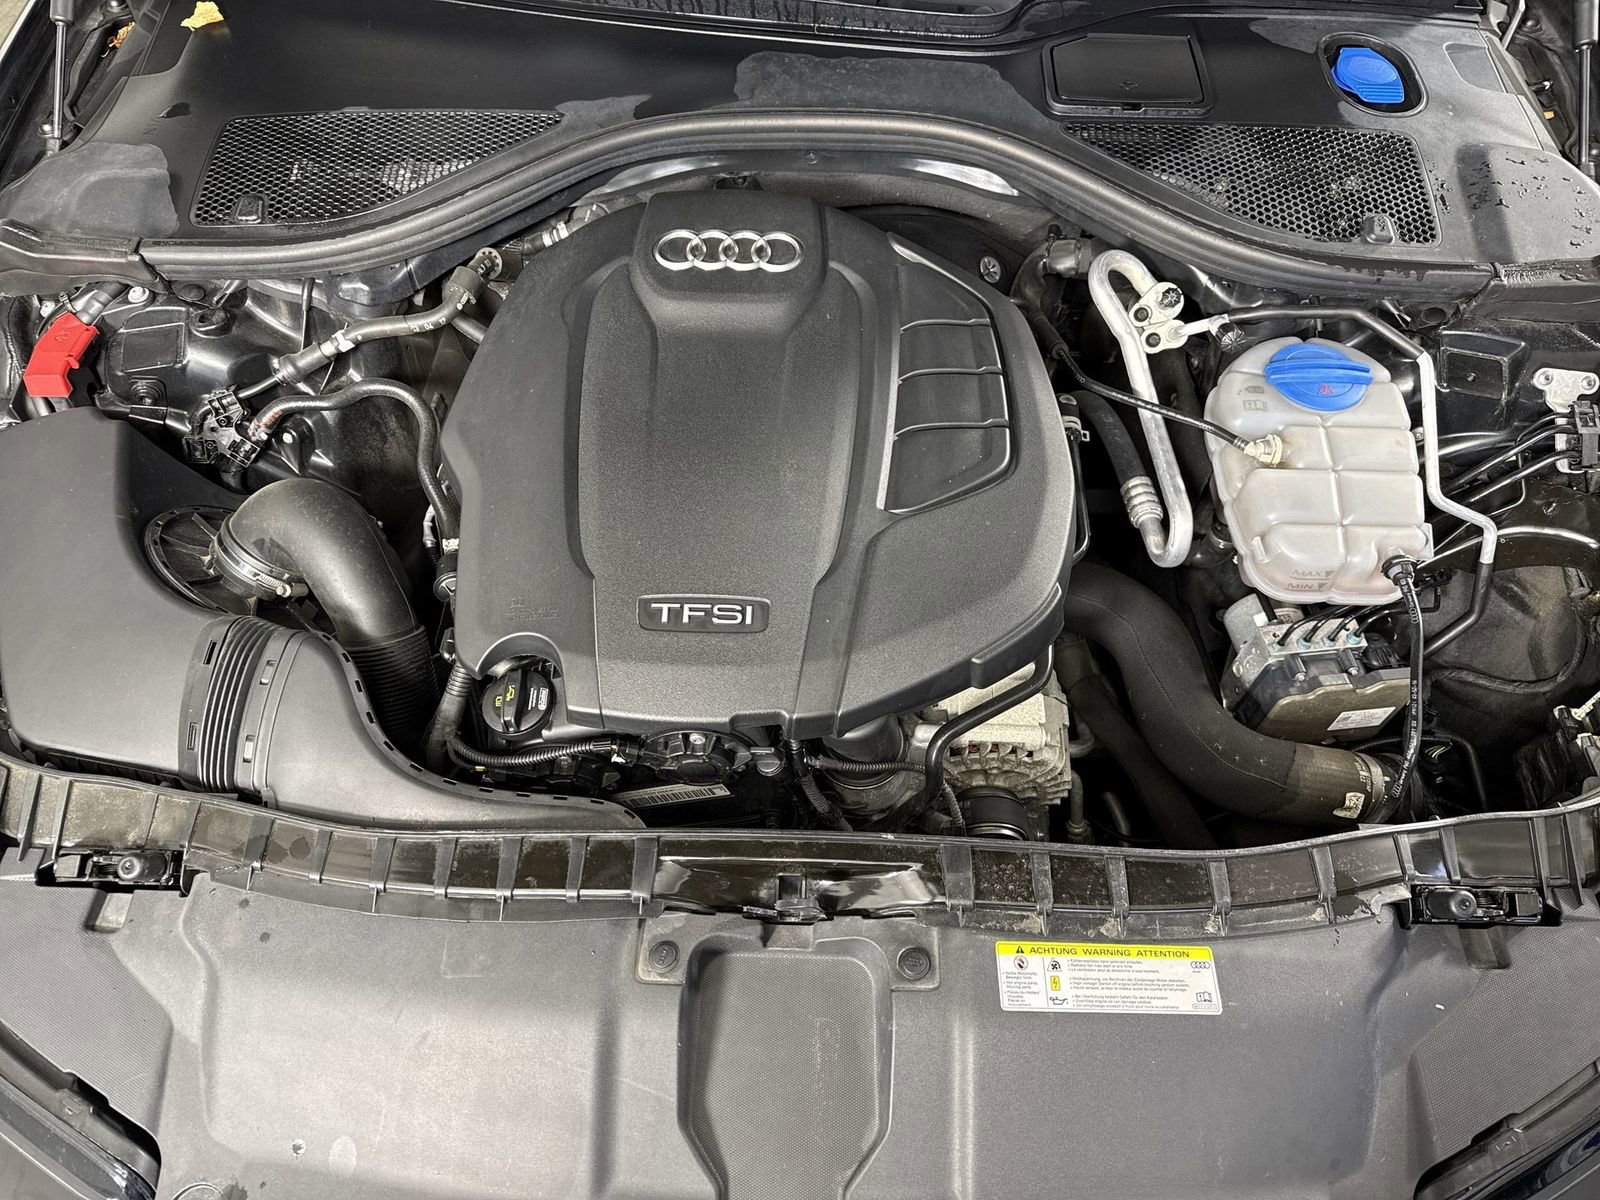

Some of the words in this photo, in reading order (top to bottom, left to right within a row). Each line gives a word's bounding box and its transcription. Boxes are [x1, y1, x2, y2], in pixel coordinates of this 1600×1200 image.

[1292, 569, 1321, 577] MAX
[651, 603, 753, 625] TFSI
[1029, 947, 1077, 955] ACHTUNG
[1083, 949, 1131, 957] WARNING
[1136, 950, 1190, 958] ATTENTION
